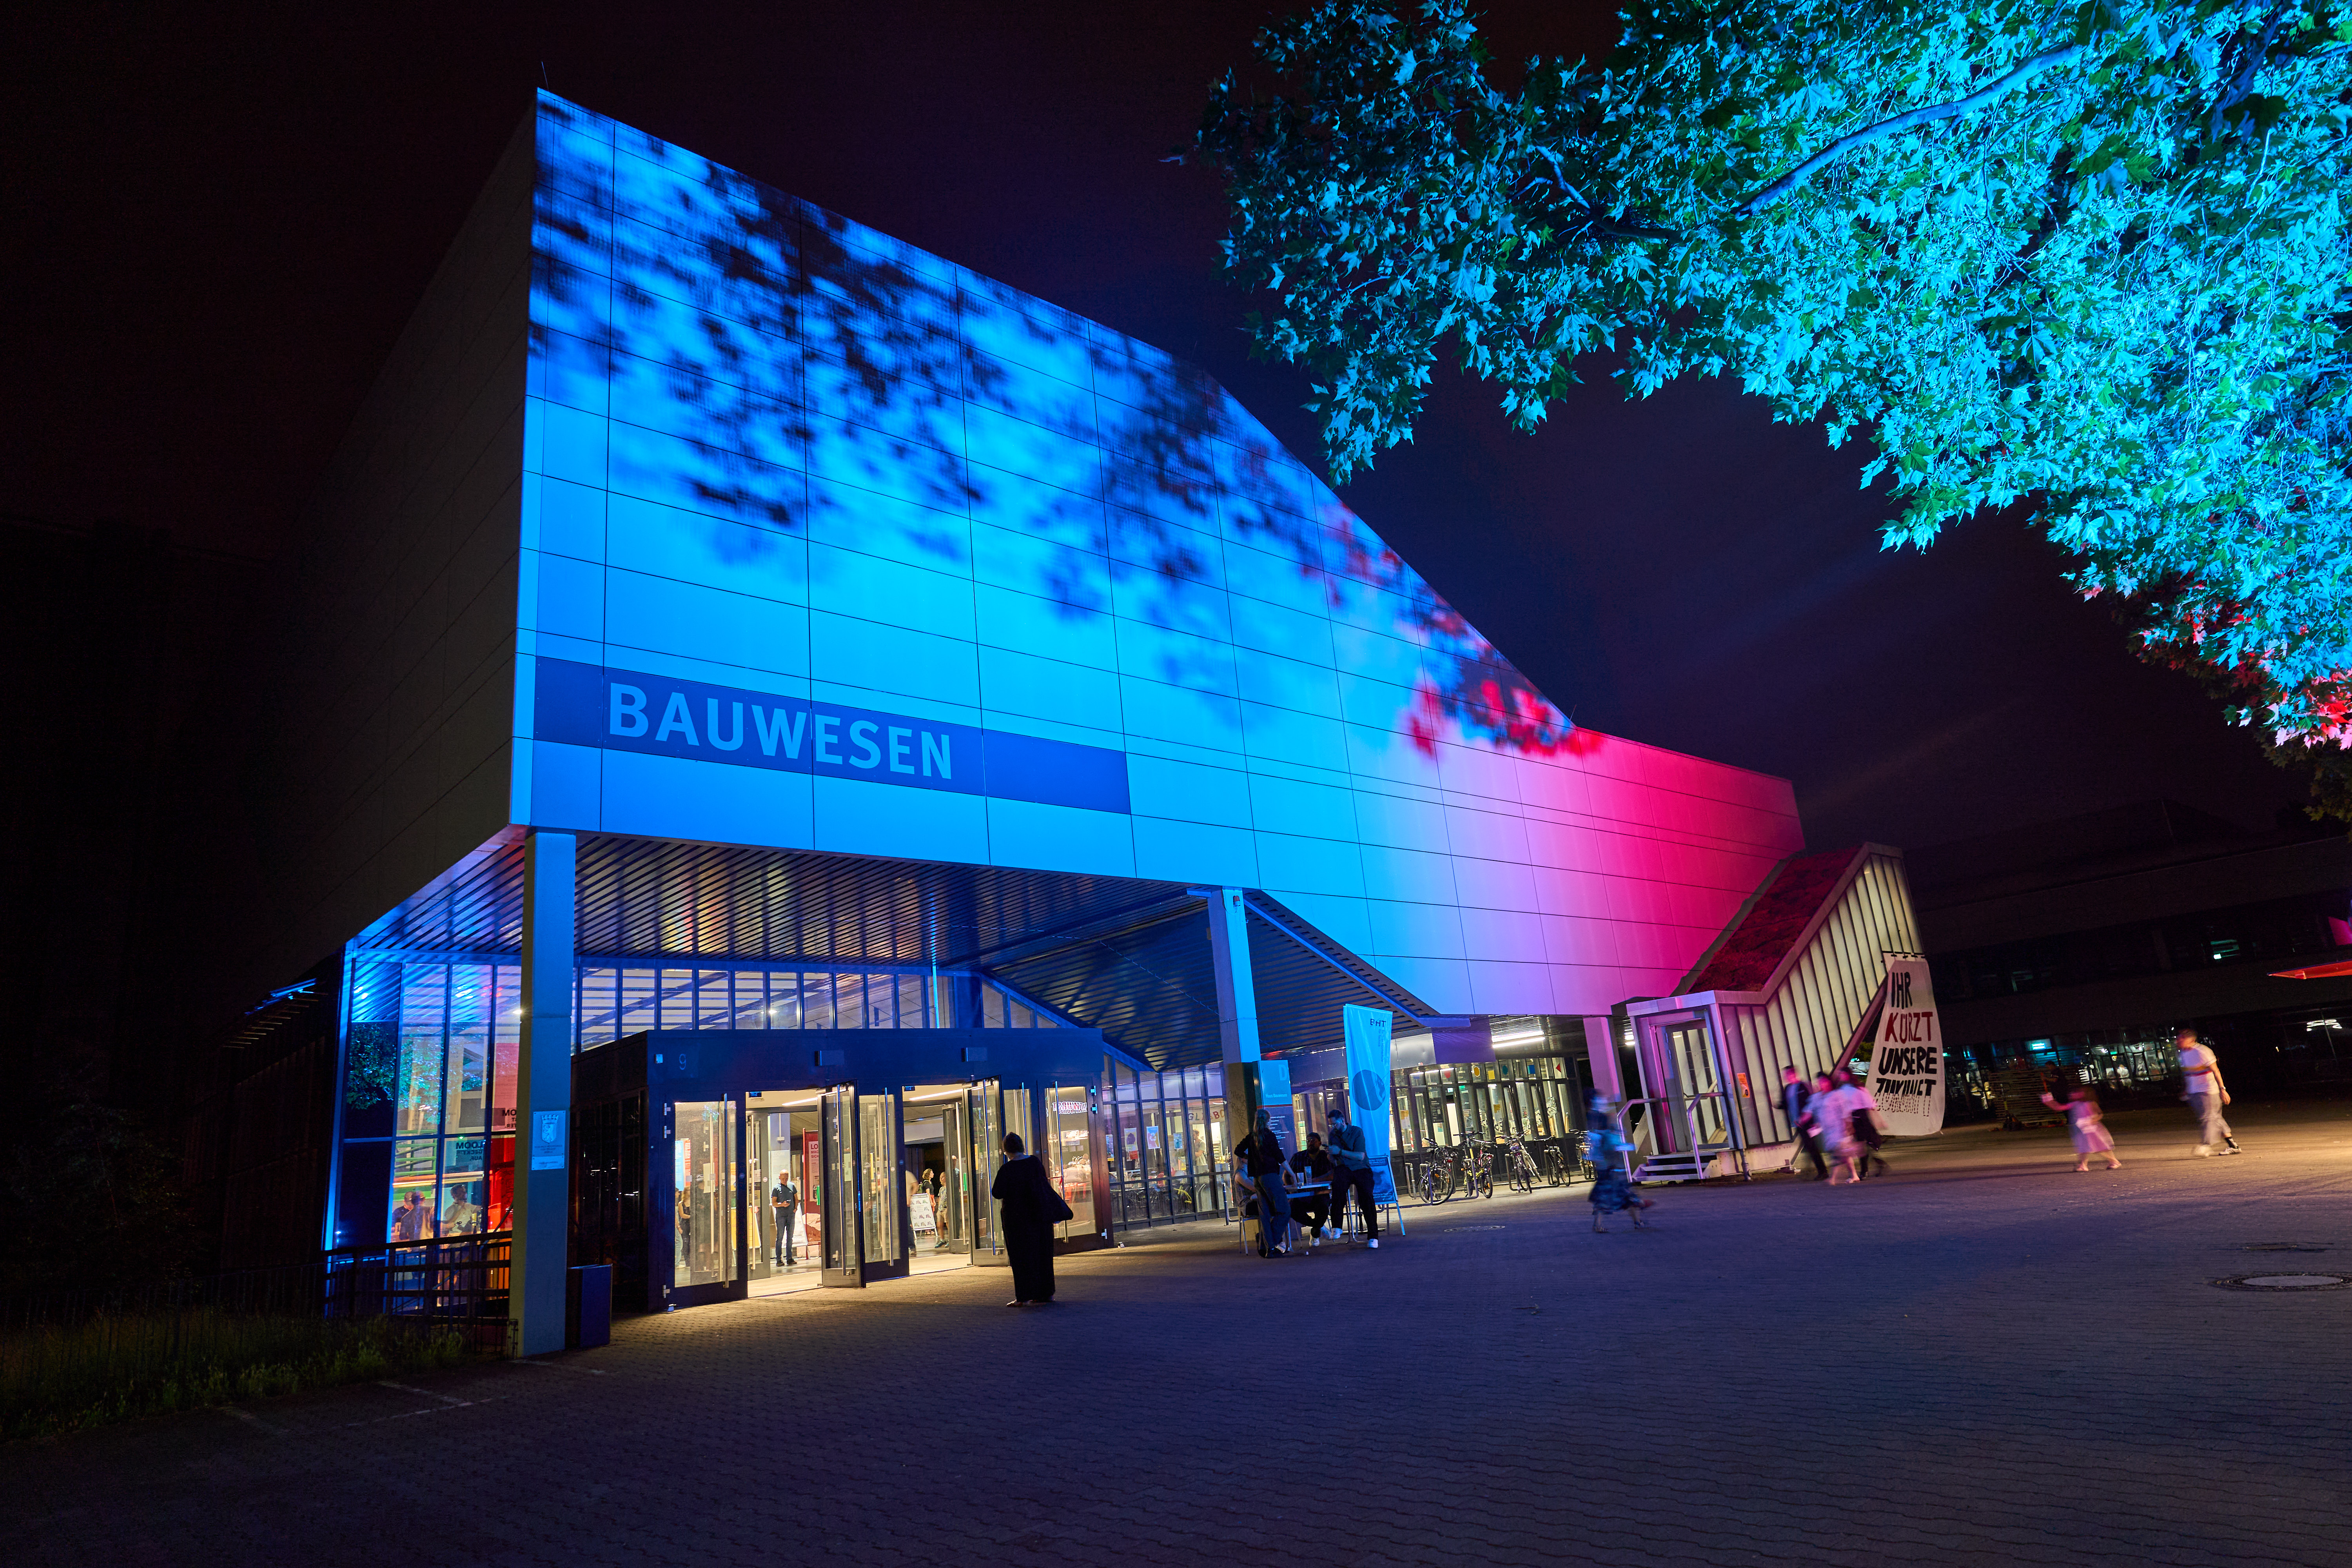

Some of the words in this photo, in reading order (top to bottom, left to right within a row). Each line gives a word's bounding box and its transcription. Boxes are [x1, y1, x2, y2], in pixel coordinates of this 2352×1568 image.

[609, 682, 952, 780] BAUWESEN
[1891, 972, 1913, 1009] IHR
[1370, 1018, 1387, 1027] BHT
[1885, 1012, 1933, 1044] KÜRZT
[679, 1053, 687, 1070] 9
[1278, 1064, 1287, 1081] D
[1878, 1046, 1937, 1076] UNSERE
[1871, 1078, 1936, 1116] ZUKUNFT
